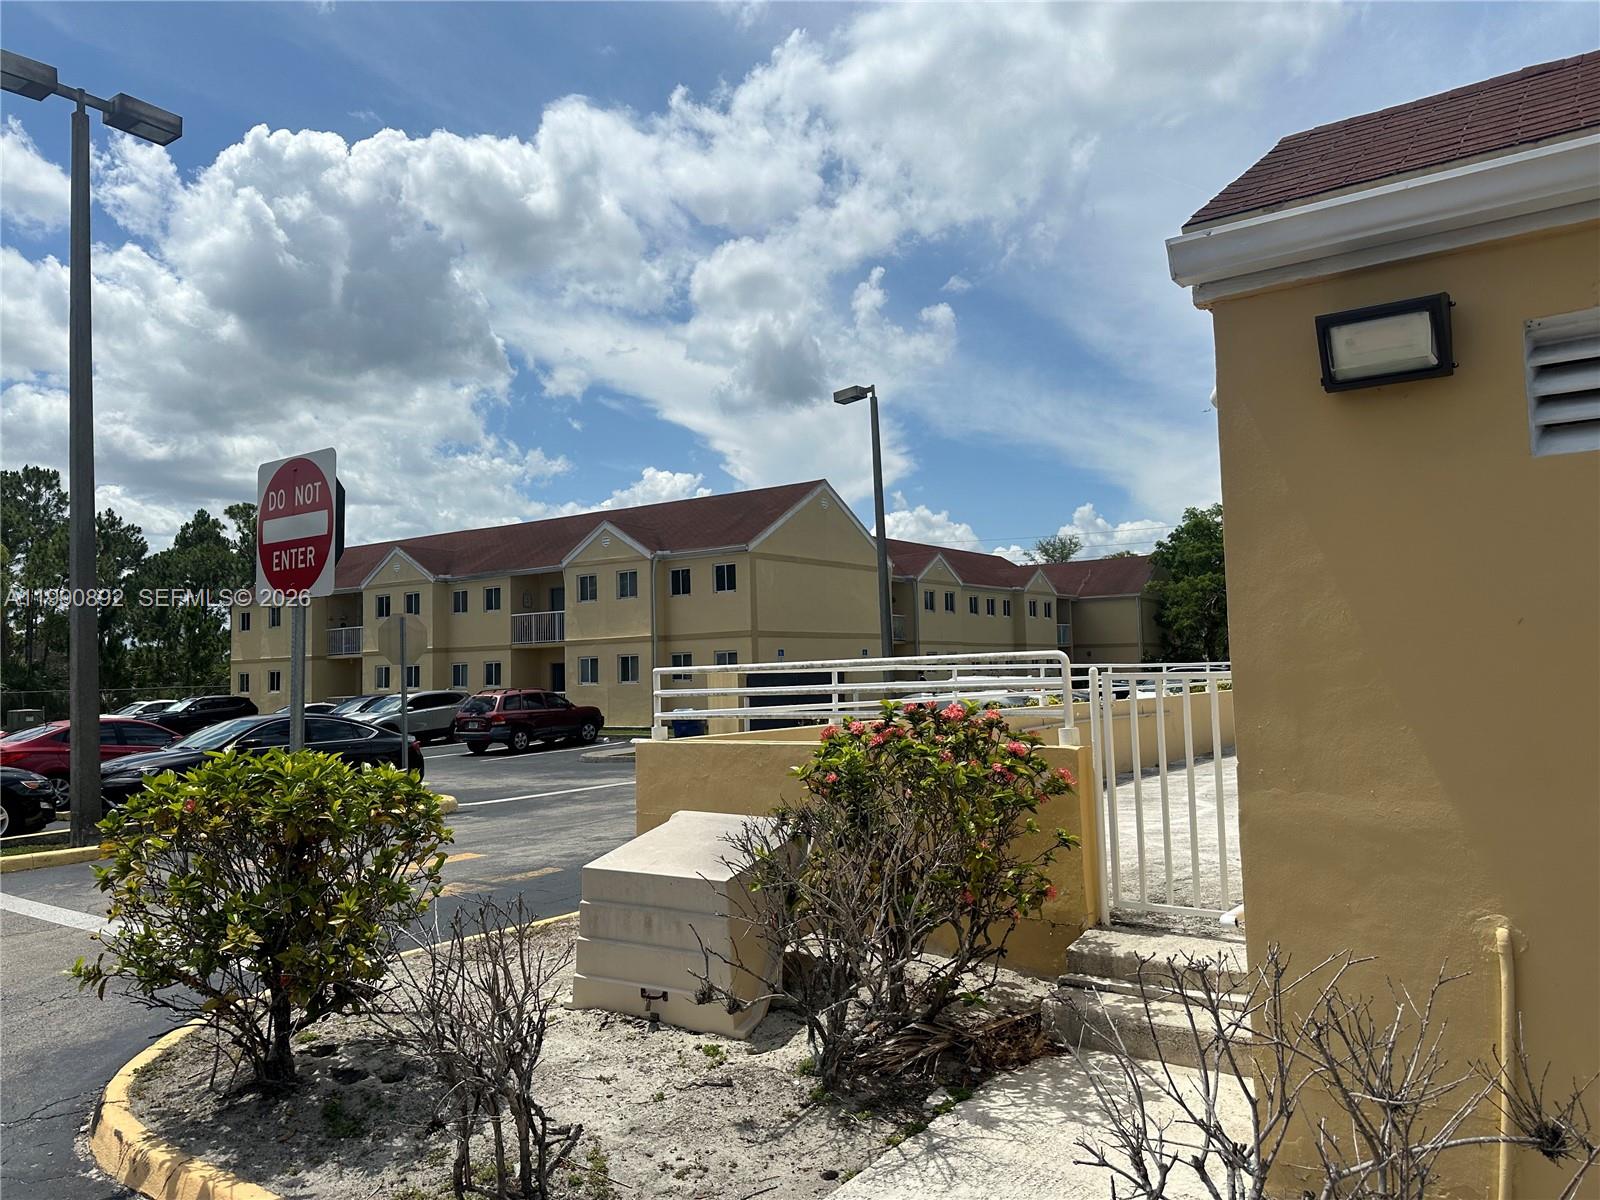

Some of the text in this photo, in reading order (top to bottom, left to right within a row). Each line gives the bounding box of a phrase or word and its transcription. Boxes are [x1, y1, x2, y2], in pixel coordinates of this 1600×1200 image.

[268, 482, 322, 512] DO NOT
[272, 546, 316, 572] ENTER
